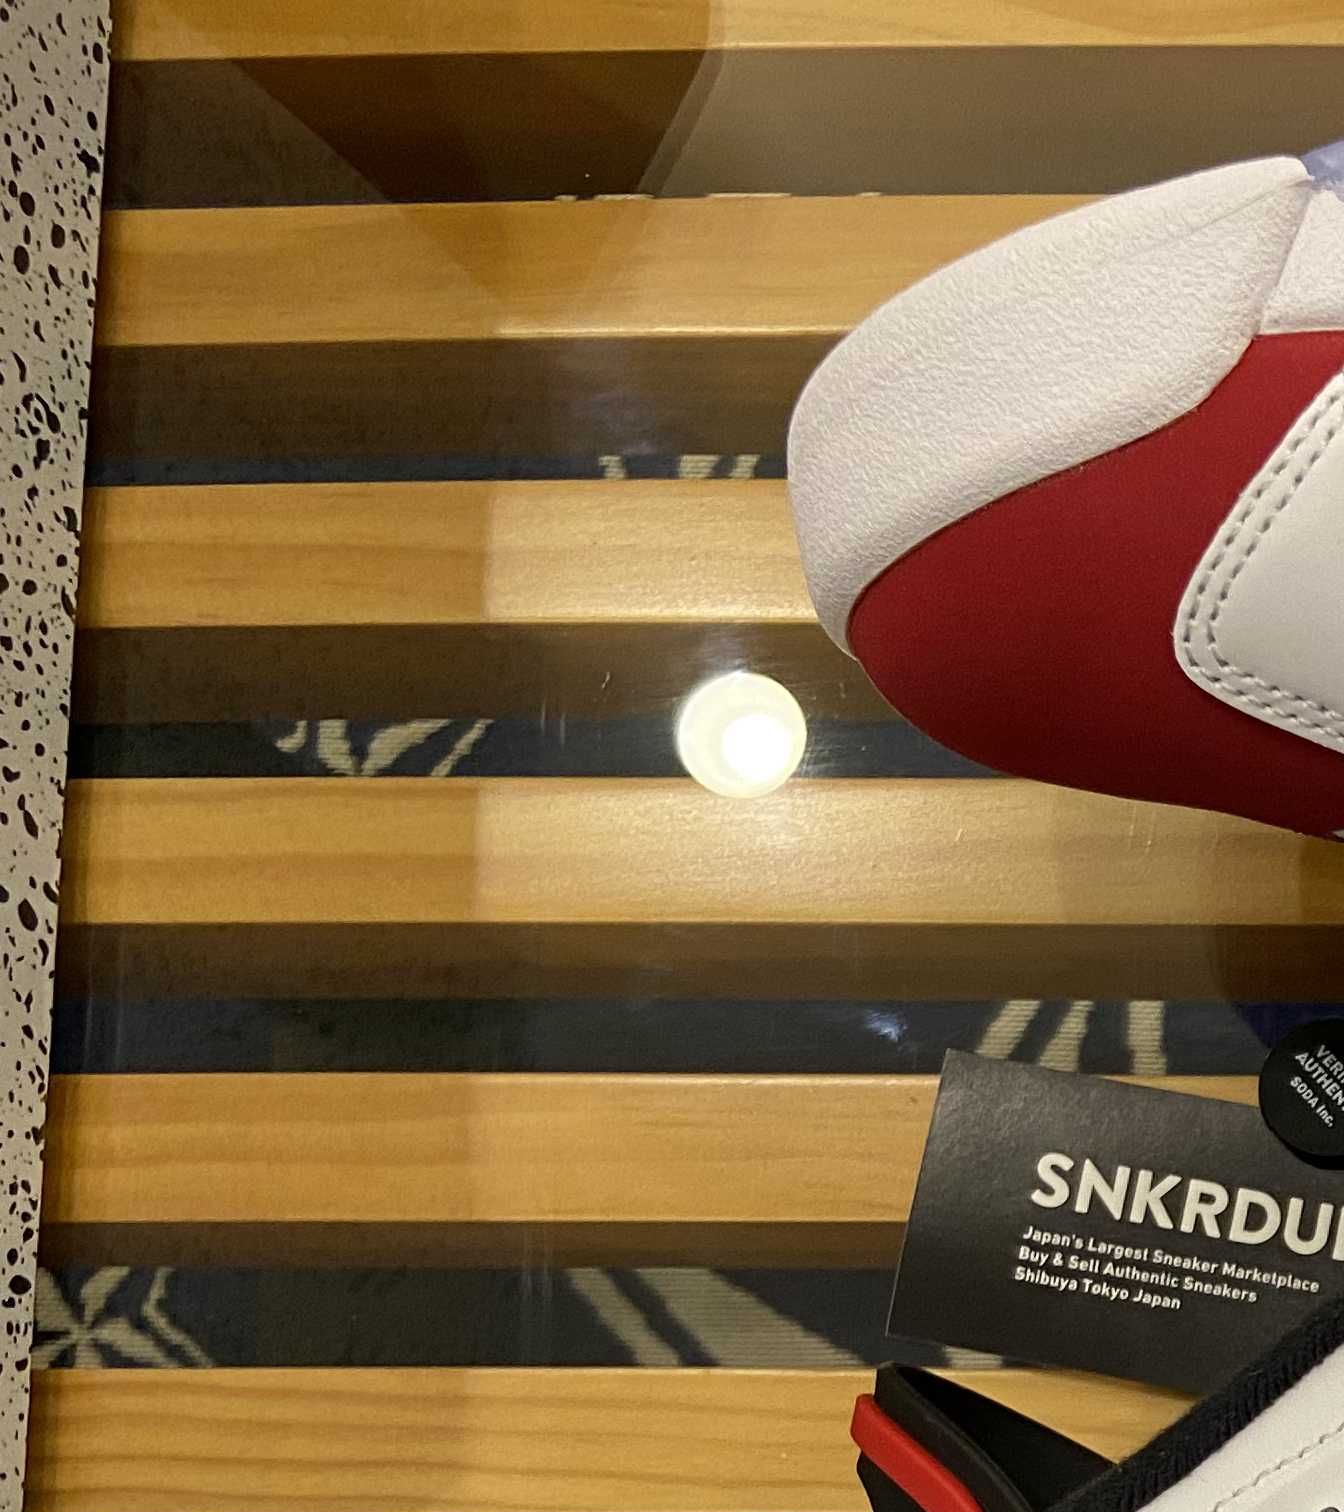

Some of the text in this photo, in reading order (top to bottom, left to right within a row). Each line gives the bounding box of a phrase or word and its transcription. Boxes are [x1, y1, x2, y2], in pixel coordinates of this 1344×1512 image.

[1290, 1076, 1319, 1108] SODA
[1018, 1246, 1257, 1303] Buy & Sell Authentic Sneakers
[1022, 1225, 1320, 1293] Japan's Largest Sneaker Marketplace
[1014, 1265, 1182, 1311] Shibuya Tokyo Japan
